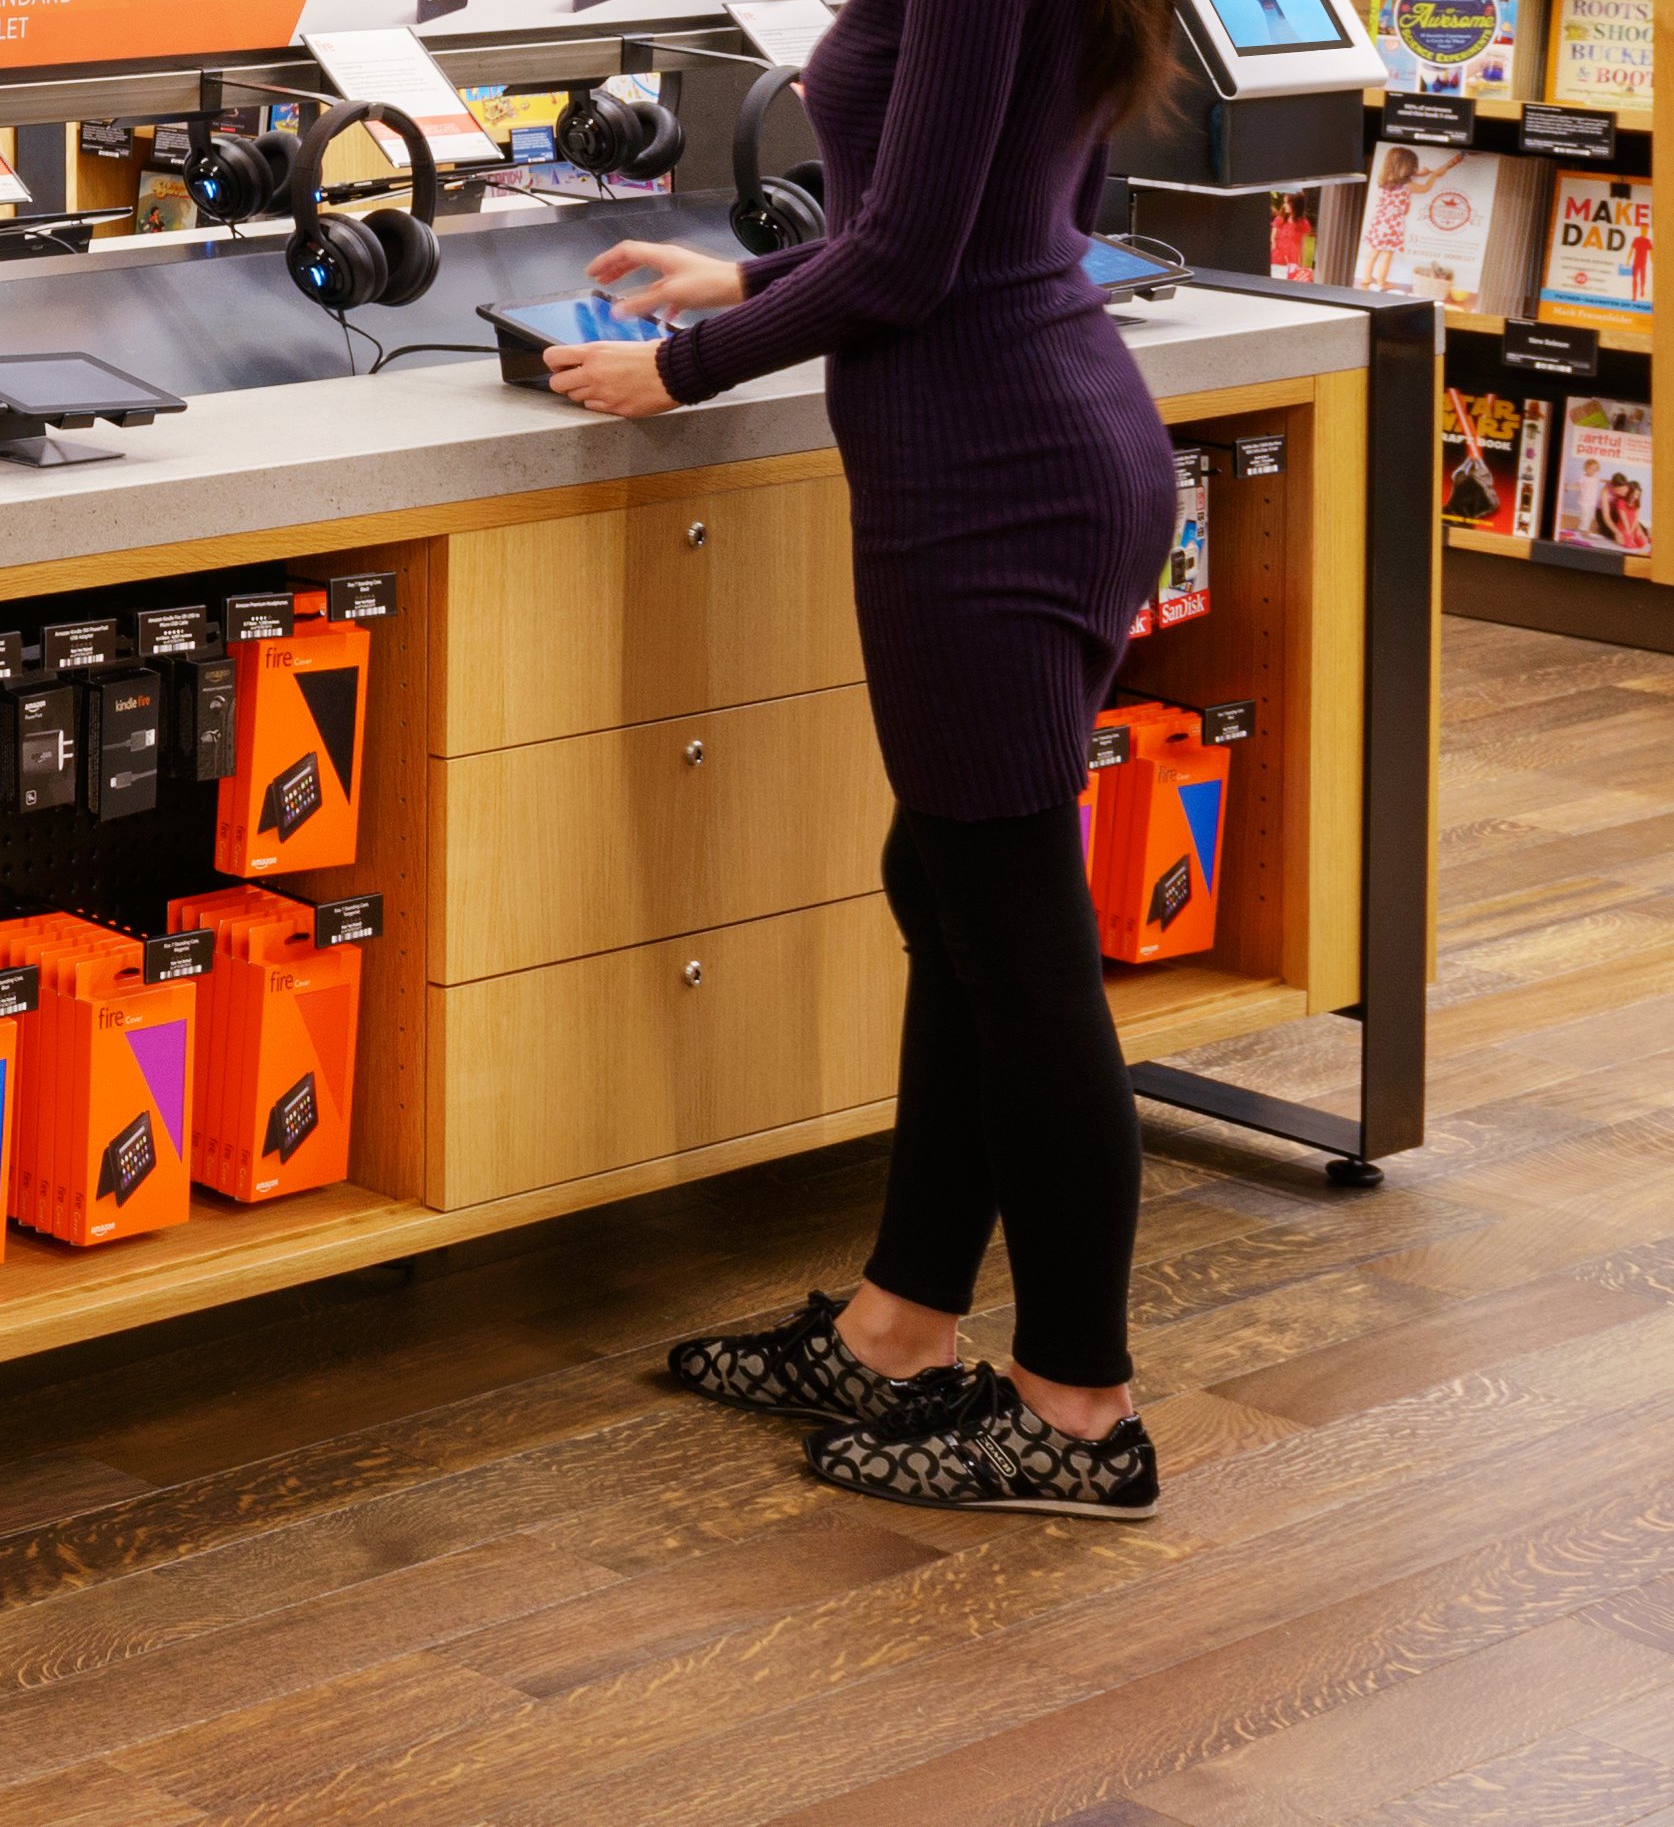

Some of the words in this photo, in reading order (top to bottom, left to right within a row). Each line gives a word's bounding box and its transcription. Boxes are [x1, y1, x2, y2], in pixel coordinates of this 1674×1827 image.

[1565, 196, 1650, 226] MAKE
[1562, 223, 1625, 251] DAD
[1162, 594, 1205, 622] SanDisk
[266, 647, 293, 668] fire
